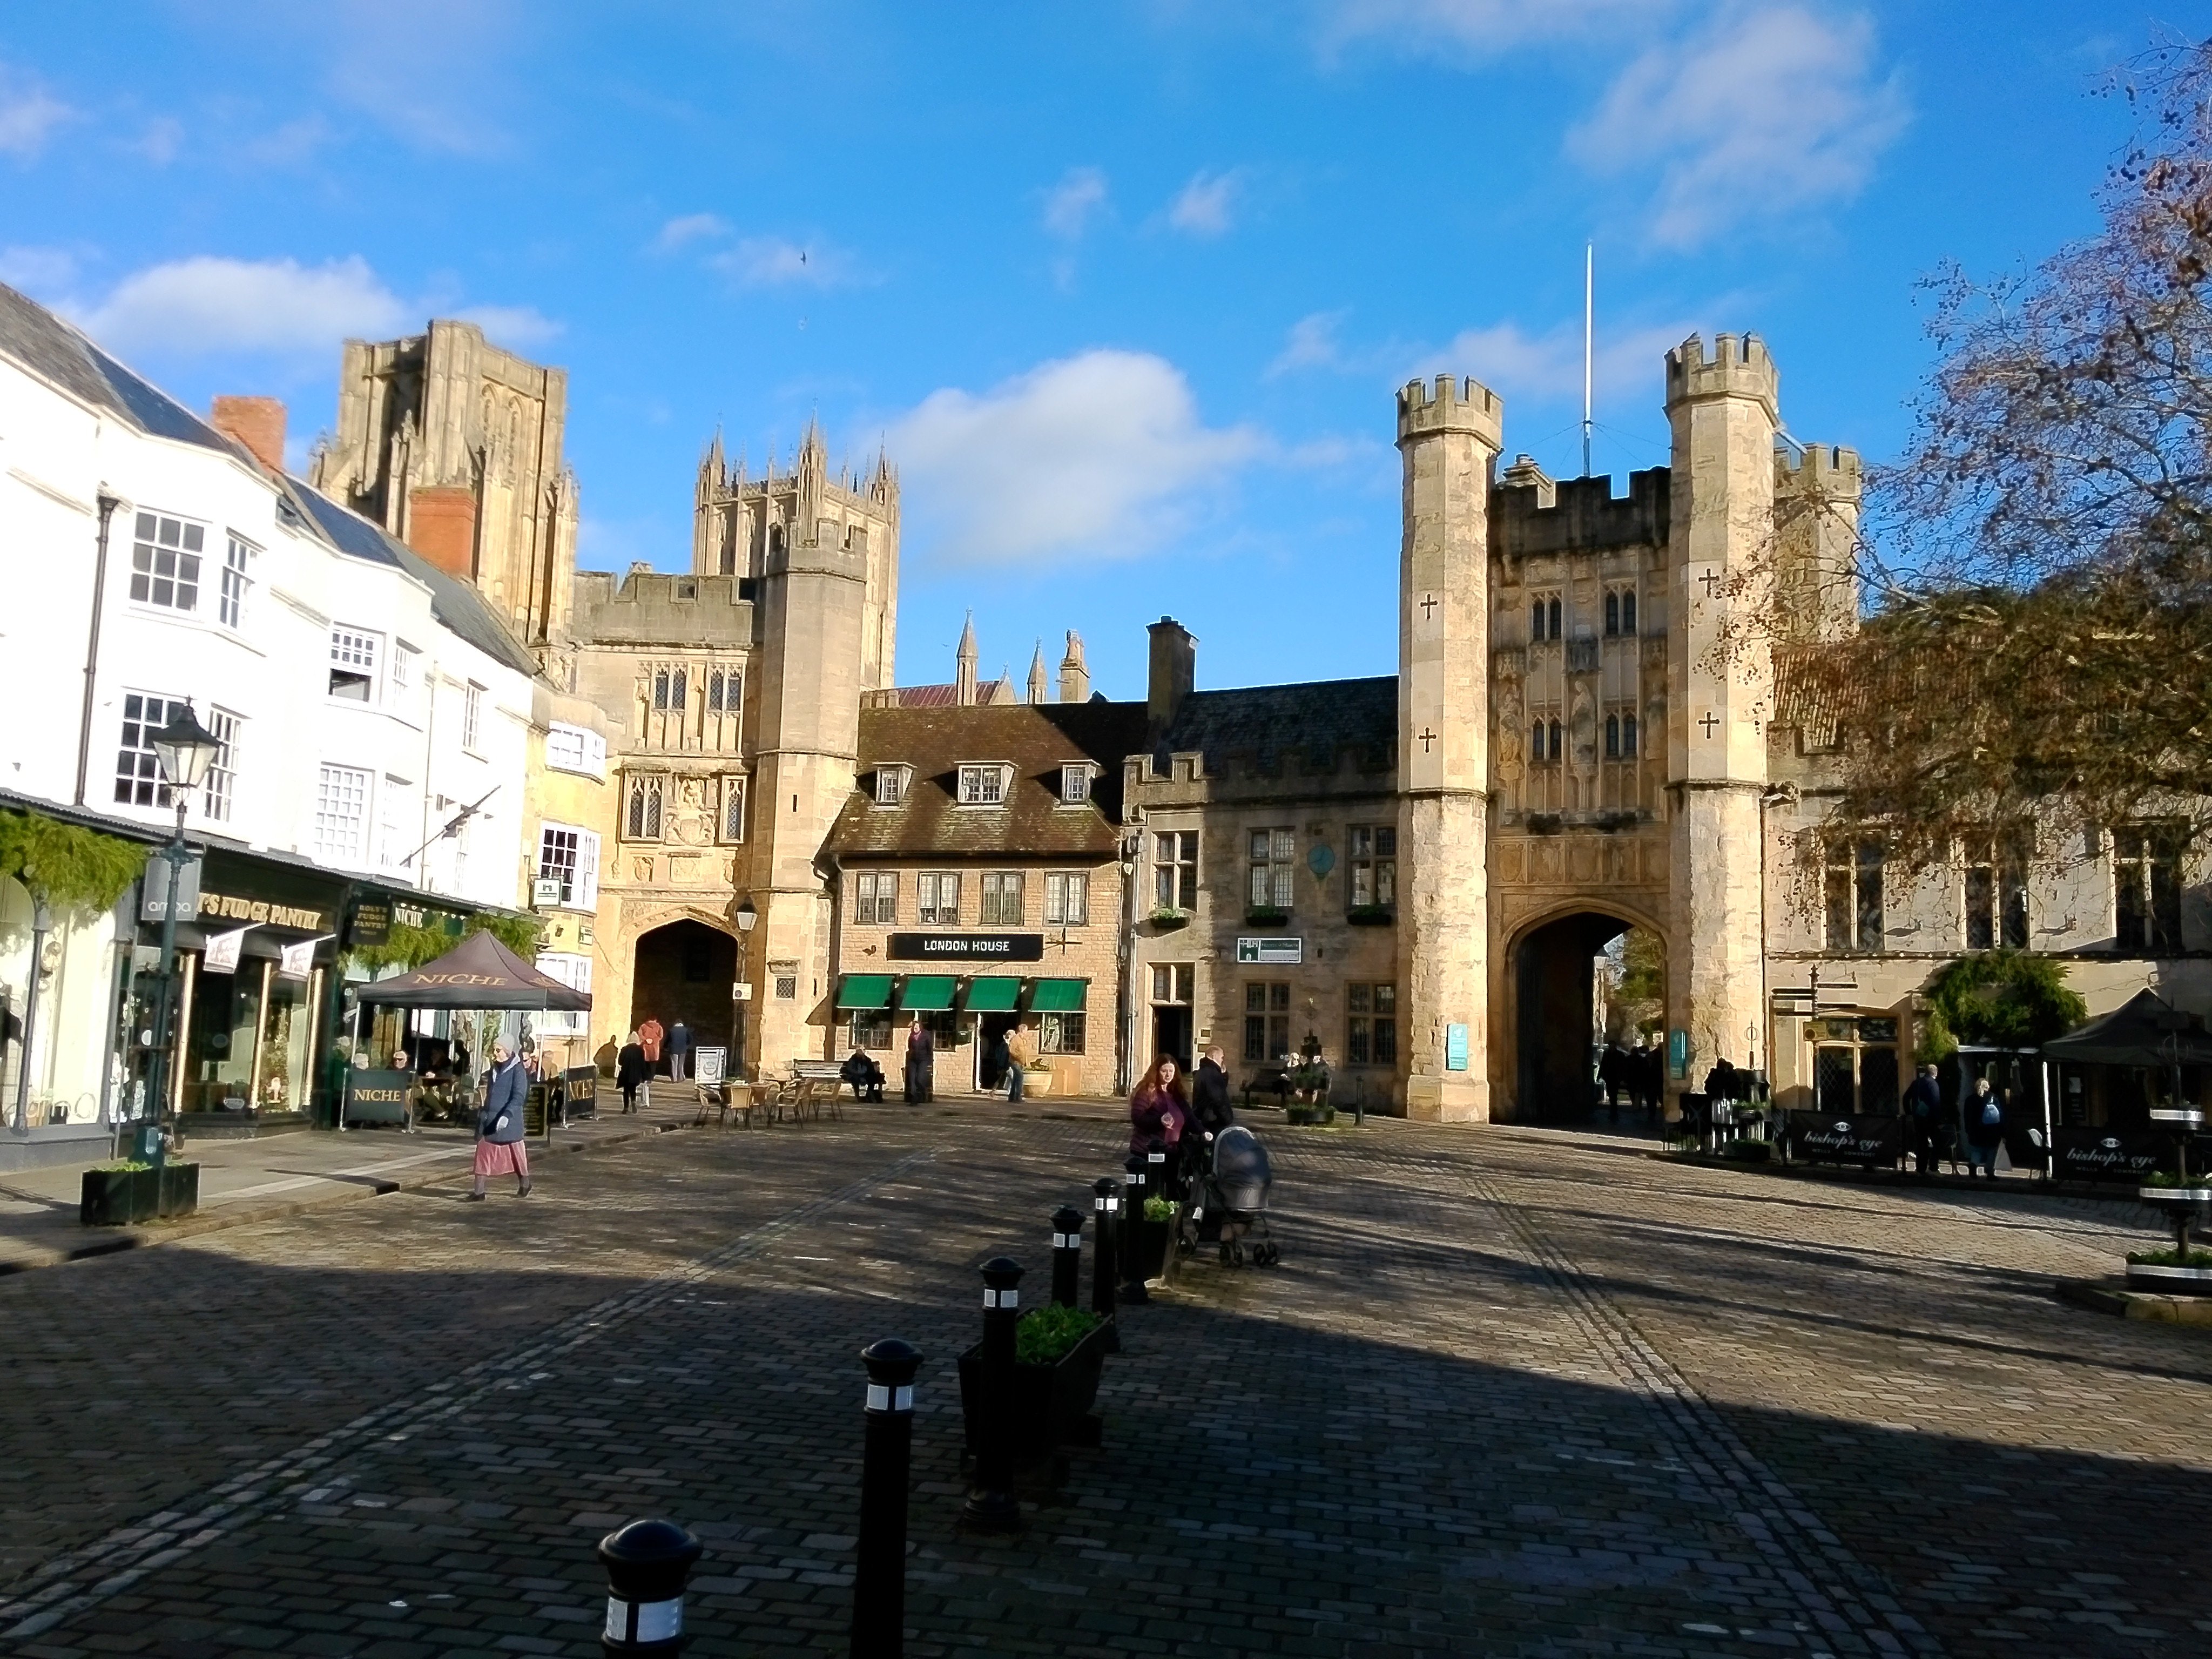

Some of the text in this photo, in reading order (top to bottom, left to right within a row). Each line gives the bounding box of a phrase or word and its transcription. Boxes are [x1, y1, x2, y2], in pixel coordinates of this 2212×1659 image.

[220, 896, 269, 923] FUDGE
[269, 905, 321, 929] PANTRY
[394, 907, 423, 928] NICHE
[925, 940, 1010, 952] LONDON HOUSE
[413, 974, 509, 986] NICHE
[354, 1089, 401, 1101] NICHE
[1804, 1130, 1883, 1151] bishop's eye
[2067, 1147, 2156, 1168] bishop's eye
